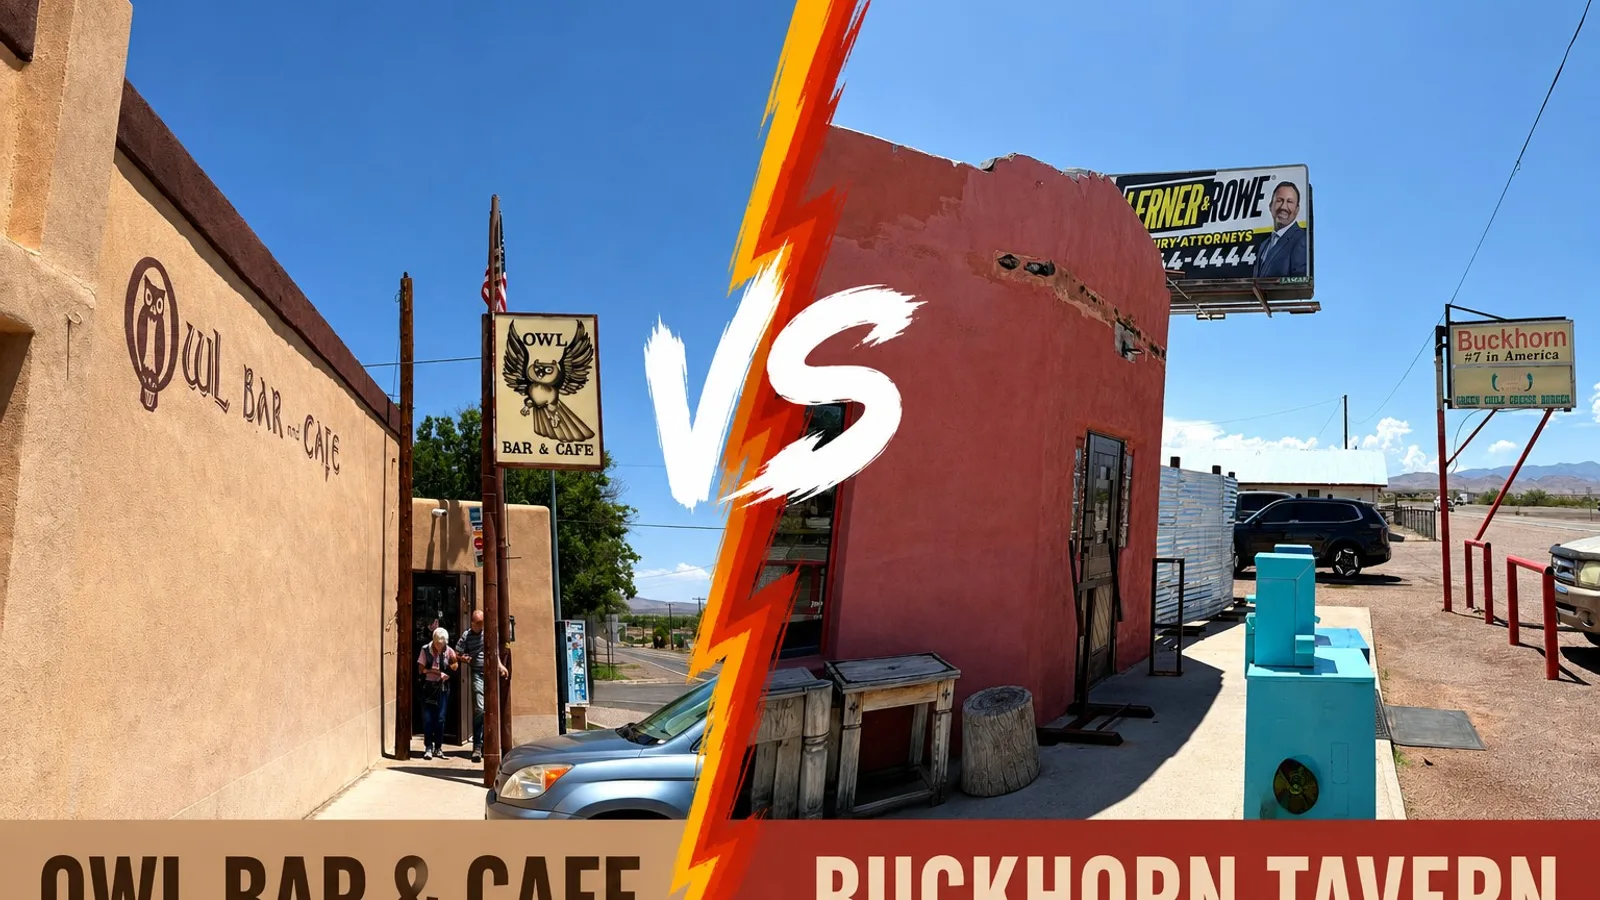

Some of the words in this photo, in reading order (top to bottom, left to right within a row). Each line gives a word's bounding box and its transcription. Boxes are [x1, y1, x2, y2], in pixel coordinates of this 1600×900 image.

[1180, 231, 1253, 247] ATTORNEYS
[1161, 245, 1257, 271] 4-4444
[523, 332, 568, 347] OWL
[1458, 328, 1567, 352] Buckhorn
[1464, 352, 1481, 363] #7
[1486, 351, 1499, 362] in
[1504, 350, 1560, 362] America
[243, 364, 284, 439] BAR
[303, 414, 340, 482] CAFE
[502, 441, 533, 454] BAR
[539, 443, 549, 455] &
[555, 443, 594, 456] CAFE
